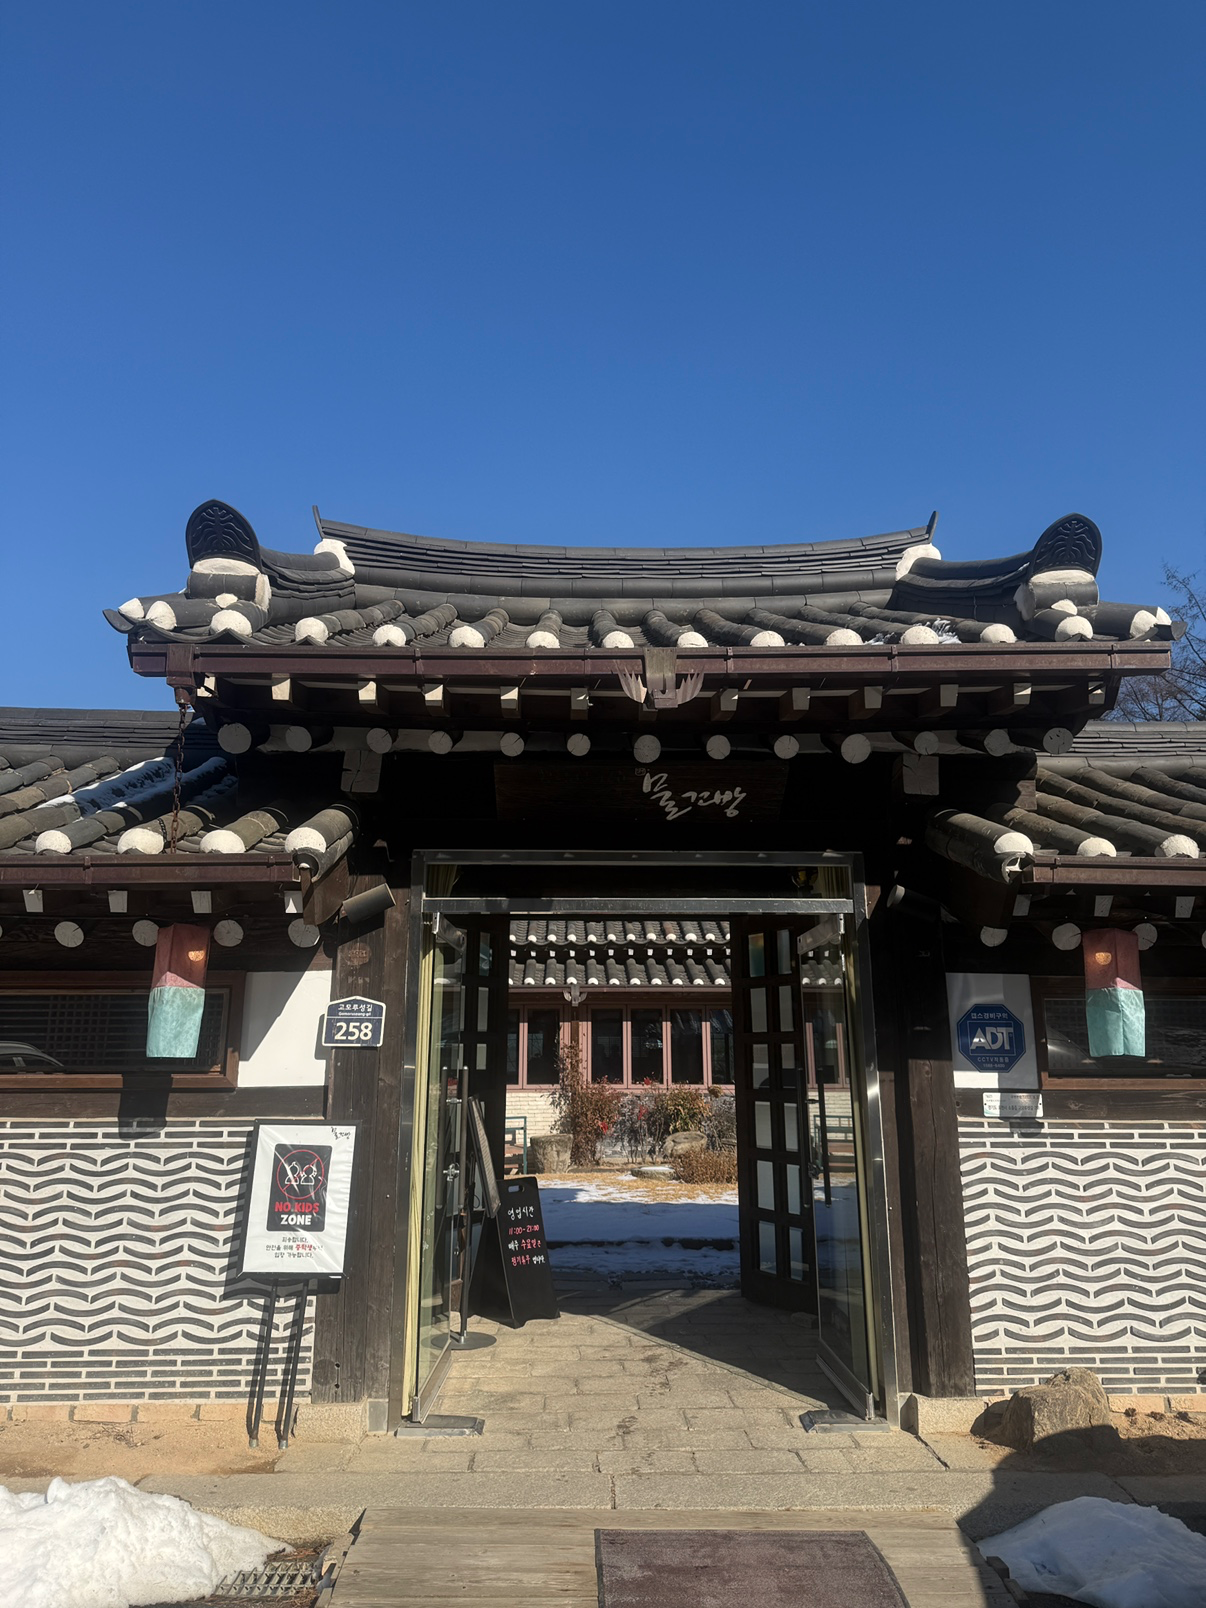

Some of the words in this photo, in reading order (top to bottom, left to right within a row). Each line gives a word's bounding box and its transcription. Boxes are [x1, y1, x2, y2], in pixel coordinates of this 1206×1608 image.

[338, 1004, 373, 1012] 고모루성길
[335, 1022, 372, 1040] 258
[970, 1027, 1013, 1050] ADT
[274, 1202, 291, 1212] NO
[294, 1202, 320, 1213] KIDS
[507, 1206, 534, 1221] 영업시간
[280, 1215, 312, 1225] ZONE
